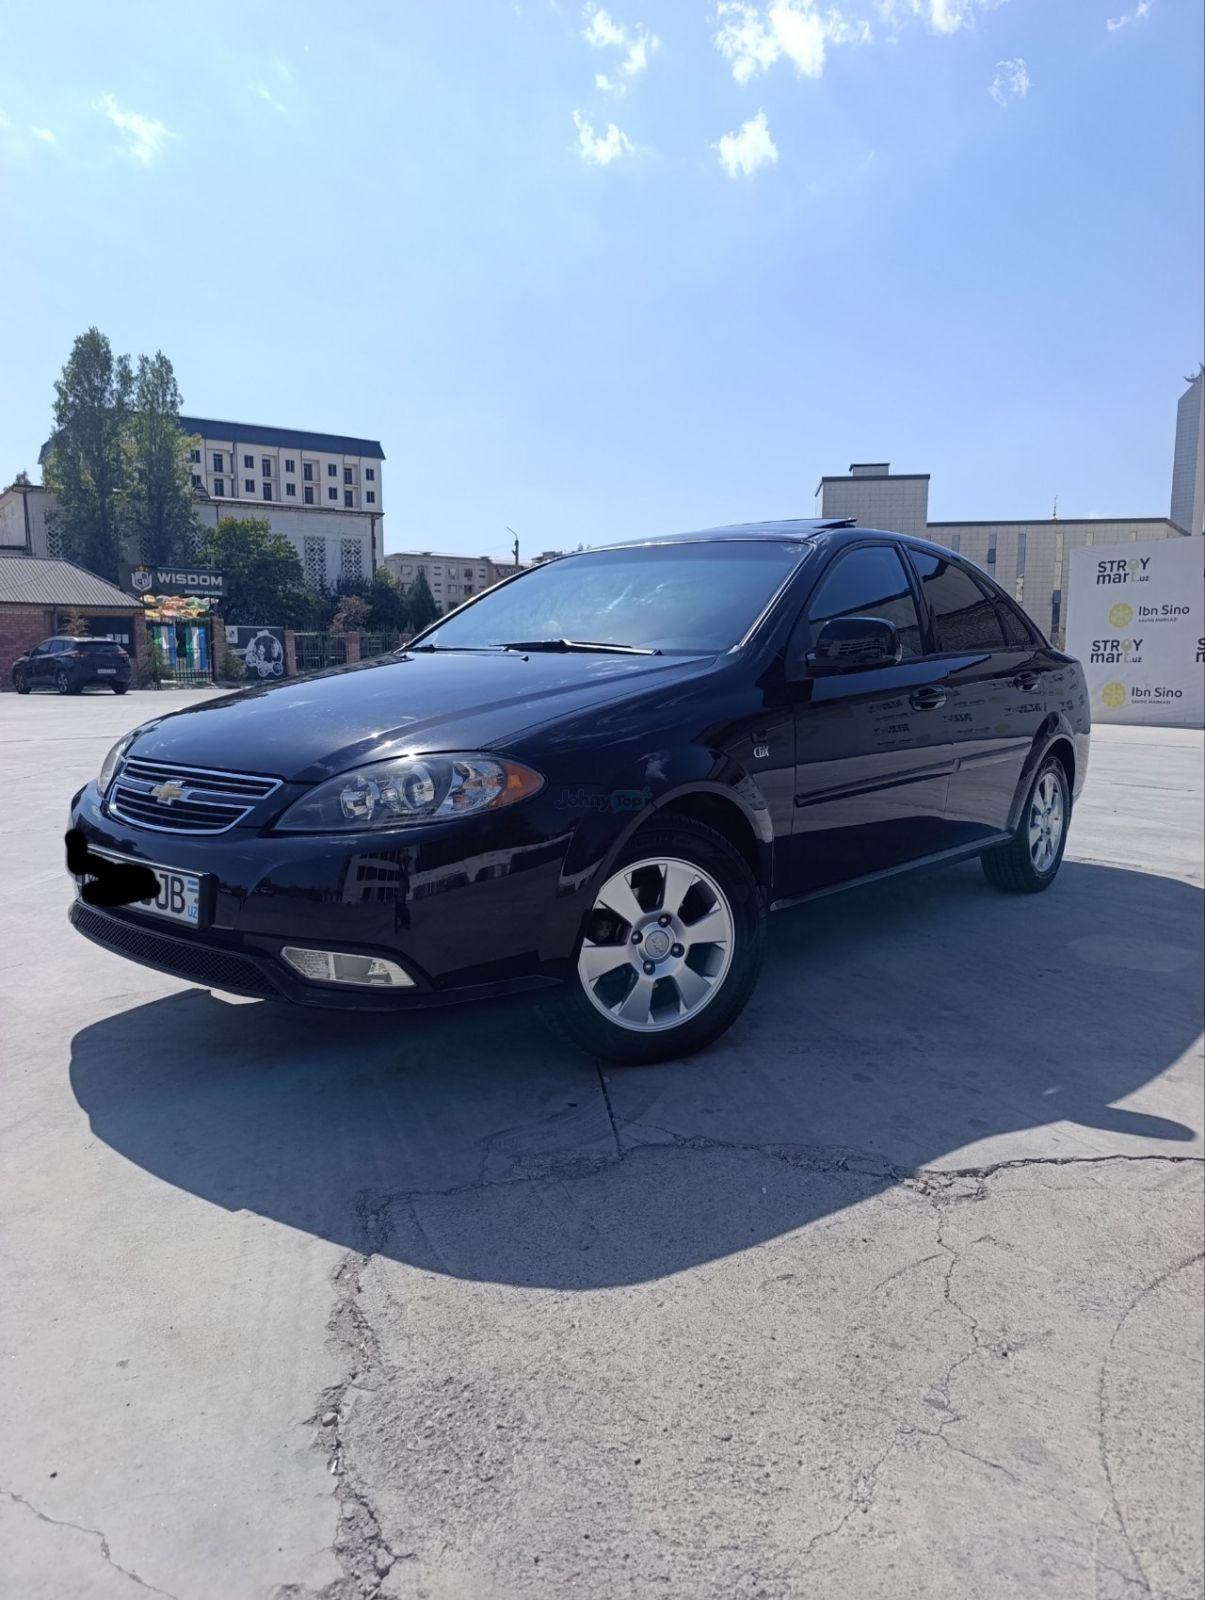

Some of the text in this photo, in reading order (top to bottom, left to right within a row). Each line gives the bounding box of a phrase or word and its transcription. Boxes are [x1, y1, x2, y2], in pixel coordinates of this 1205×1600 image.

[157, 572, 223, 586] WISDOM
[1138, 604, 1190, 616] Ibn Sino
[1131, 687, 1183, 698] Ibn Sino
[187, 906, 198, 918] UZ
